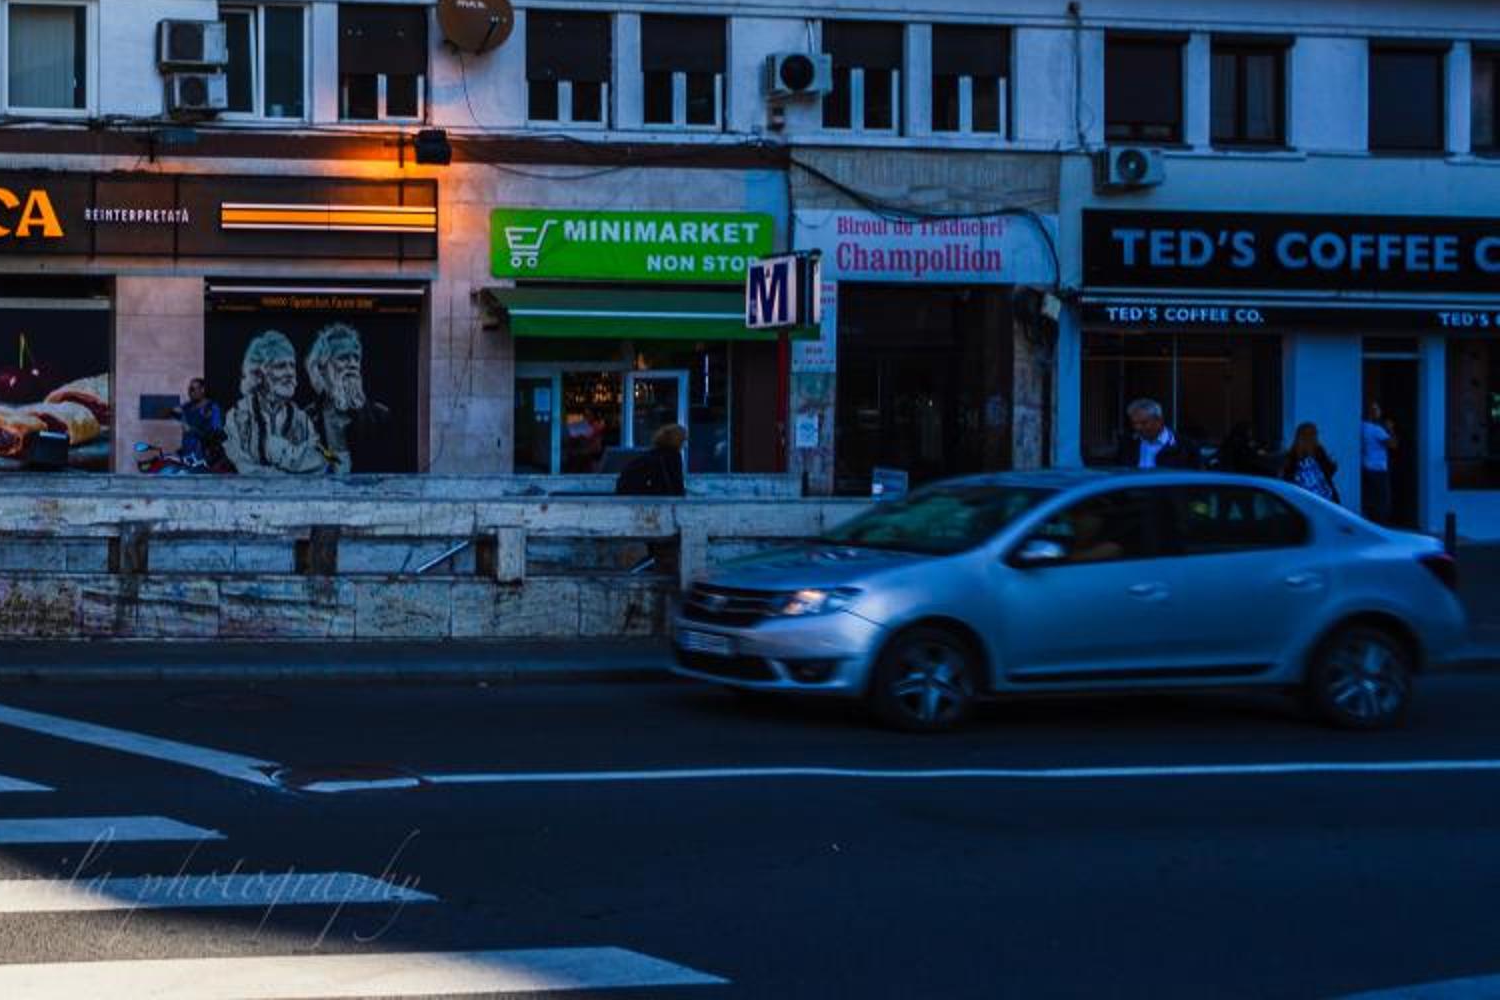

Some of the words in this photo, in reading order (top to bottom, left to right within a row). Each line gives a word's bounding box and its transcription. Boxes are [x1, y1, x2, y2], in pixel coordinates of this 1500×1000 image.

[564, 219, 760, 244] MINIMARKET
[647, 254, 694, 271] NON
[836, 243, 1002, 276] Champollion
[1112, 228, 1257, 267] TED'S
[1276, 232, 1458, 272] COFFEE
[750, 262, 789, 325] M
[1108, 307, 1157, 322] TED'S
[1164, 308, 1229, 323] COFFEE
[1235, 310, 1265, 323] CO.
[1439, 312, 1489, 327] TED'S
